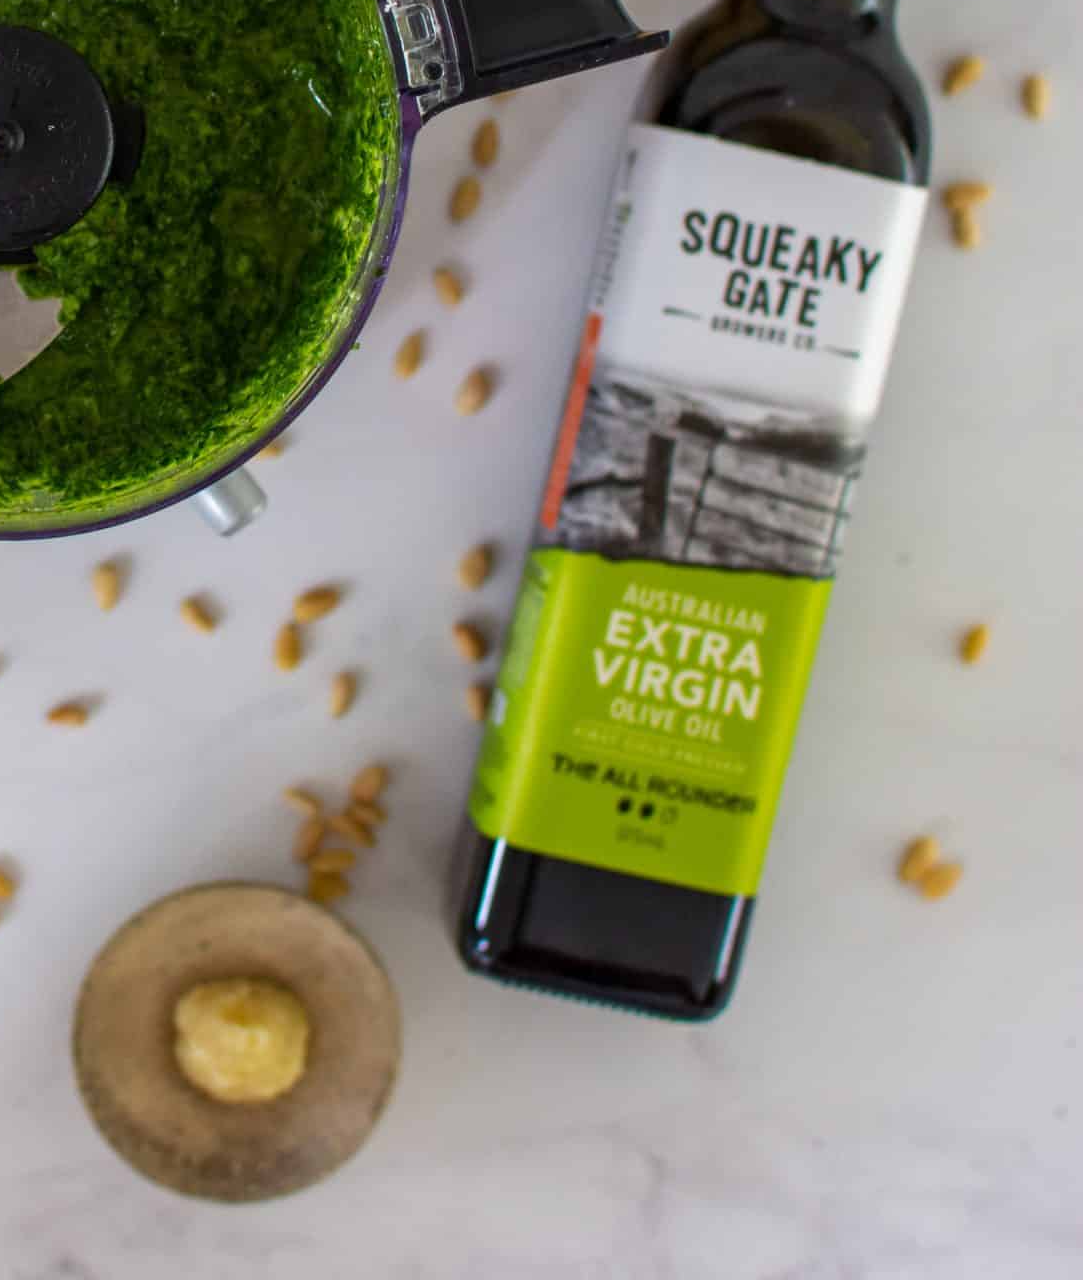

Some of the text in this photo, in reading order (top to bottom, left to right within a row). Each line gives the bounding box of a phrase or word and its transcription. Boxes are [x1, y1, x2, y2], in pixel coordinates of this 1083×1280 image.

[680, 209, 882, 294] SQUEAKY
[722, 269, 822, 328] GATE
[622, 583, 766, 635] AUSTRALIAN
[605, 607, 762, 679] EXTRA
[592, 647, 762, 721] VIRGIN
[610, 697, 724, 744] OLIVE OIL
[601, 767, 641, 792] ALL
